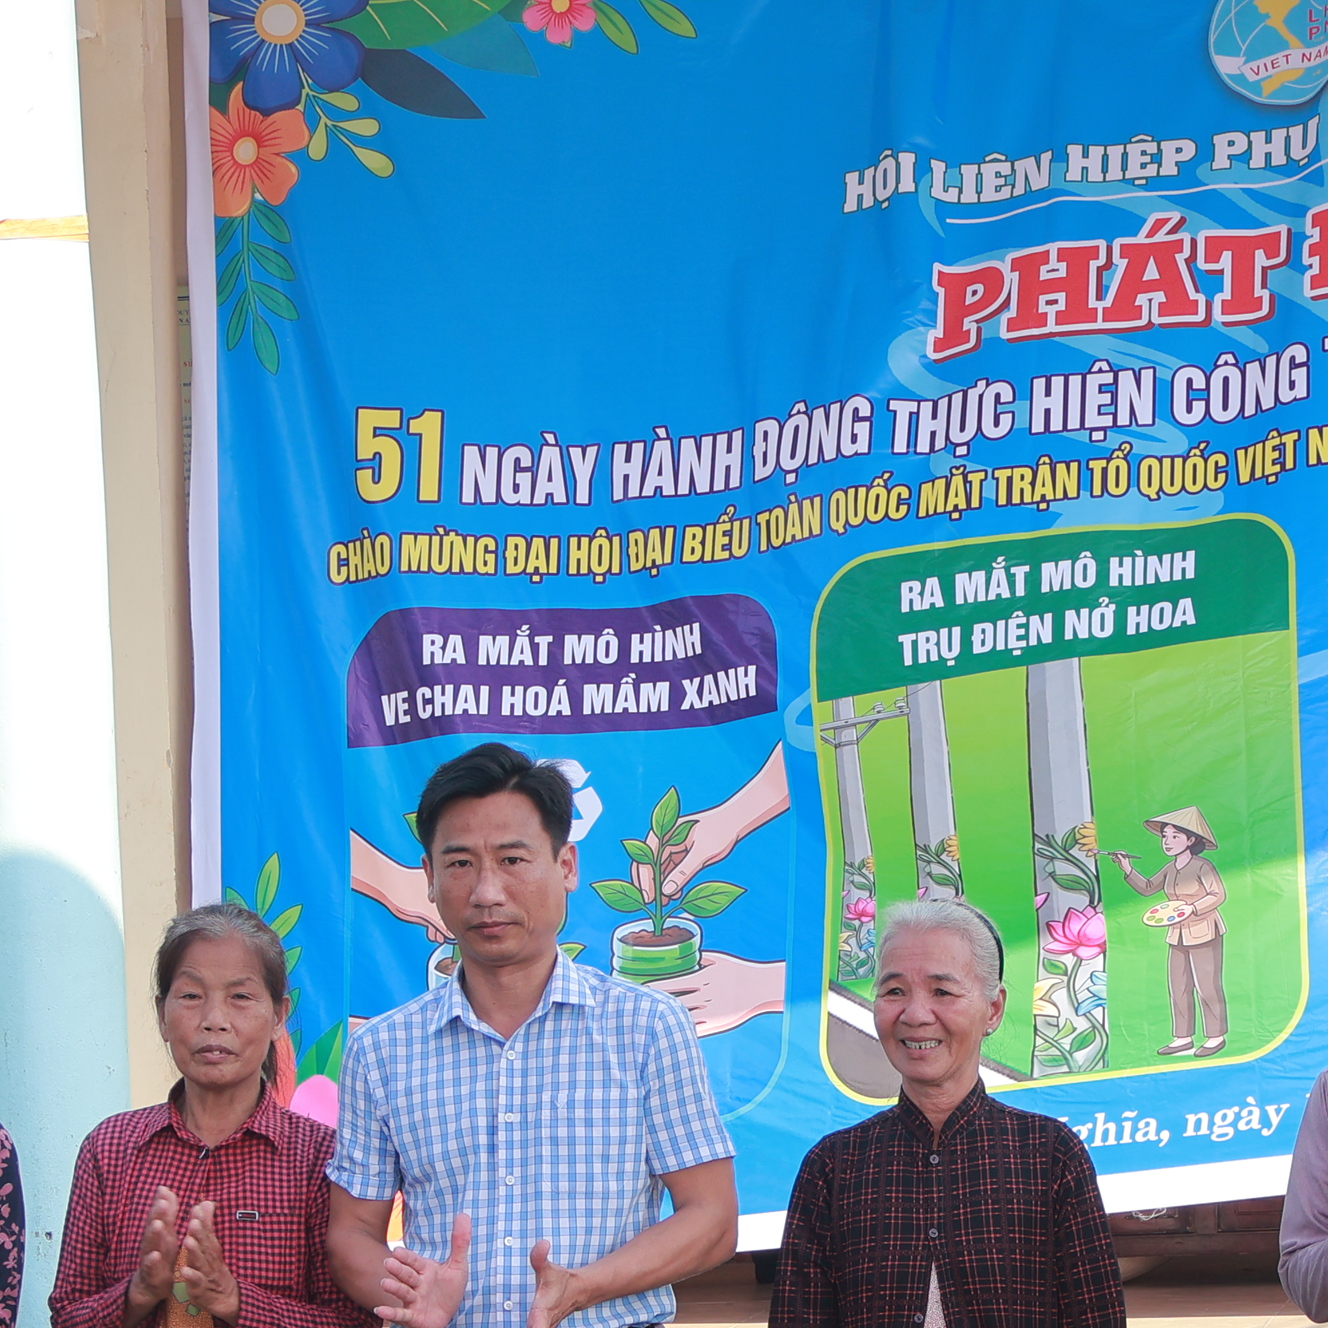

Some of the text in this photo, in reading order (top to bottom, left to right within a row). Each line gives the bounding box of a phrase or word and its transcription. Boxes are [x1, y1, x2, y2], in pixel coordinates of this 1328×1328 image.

[1249, 53, 1292, 77] VIET
[843, 150, 915, 214] HỘI
[929, 149, 1054, 204] LIÊN
[1064, 131, 1193, 191] HIỆP
[1211, 110, 1319, 173] PHỤ
[926, 210, 1292, 363] PHÁT
[354, 407, 444, 504] 51
[461, 431, 600, 506] NGÀY
[611, 426, 743, 502] HÀNH
[753, 394, 873, 487] ĐỘNG
[887, 378, 1017, 457] THỰC
[1030, 358, 1157, 441] HIỆN
[1172, 342, 1309, 426] CÔNG
[327, 528, 392, 586] CHÀO
[399, 528, 497, 576] MỪNG
[504, 533, 559, 584] ĐẠI
[567, 528, 621, 582] HỘI
[628, 525, 674, 579] ĐẠI
[680, 505, 751, 565] BIỂU
[757, 495, 823, 554] TOÀN
[828, 470, 911, 537] QUỐC
[916, 468, 986, 521] MẶT
[994, 456, 1078, 511] TRẬN
[1088, 442, 1131, 499] TỔ
[1139, 440, 1229, 501] QUỐC
[1236, 430, 1300, 485] VIỆT
[900, 549, 1196, 613] RA MẮT MÔ HÌNH
[422, 622, 703, 666] RA MẮT MÔ HÌNH
[898, 596, 1196, 667] TRỤ ĐIỆN NỞ HOA
[381, 664, 758, 727] VE CHAI HOÁ MẦM XANH
[1057, 1110, 1171, 1150] ghĩa,
[1183, 1096, 1290, 1142] ngày
